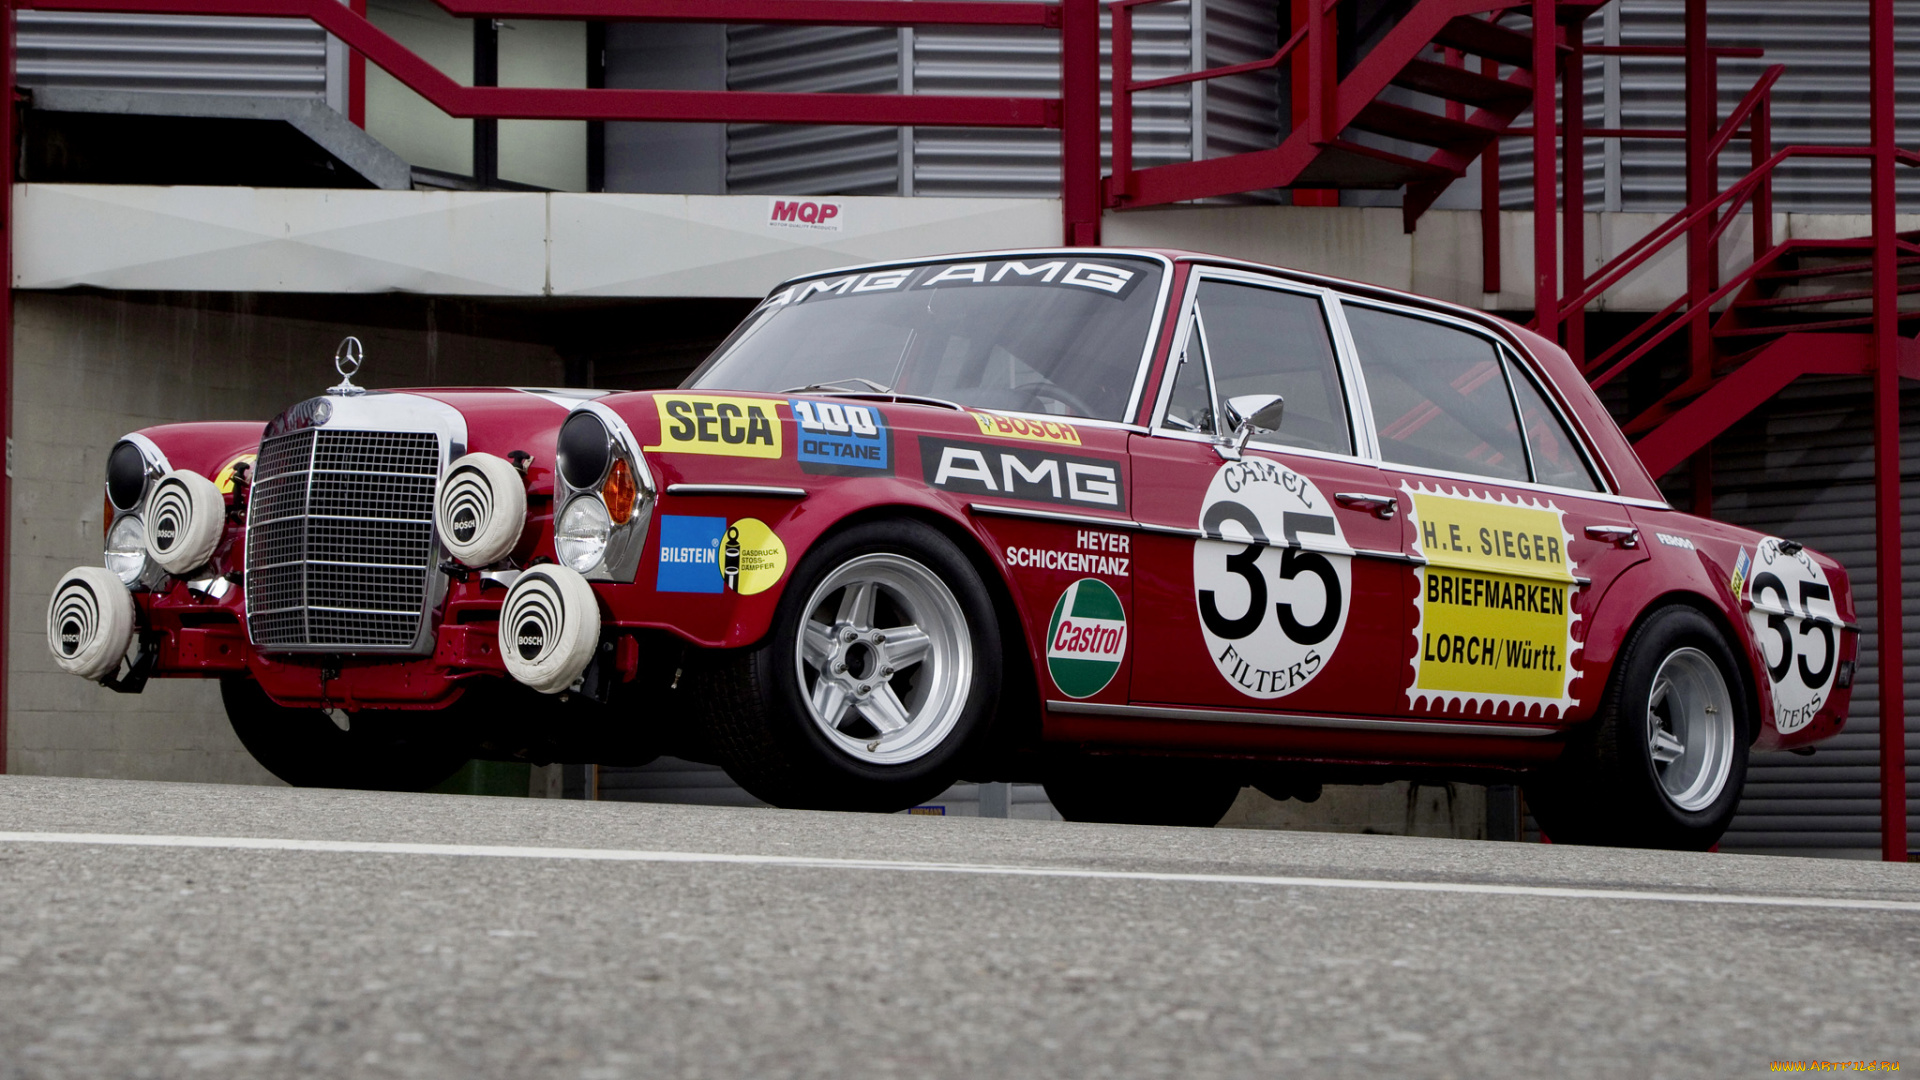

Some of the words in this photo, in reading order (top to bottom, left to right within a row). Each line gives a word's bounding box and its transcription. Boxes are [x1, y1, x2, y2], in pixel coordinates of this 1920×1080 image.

[771, 201, 838, 224] MQP
[756, 268, 915, 310] AMG
[922, 261, 1135, 294] AMG
[666, 400, 774, 446] SECA
[795, 400, 879, 436] 100
[990, 415, 1078, 442] BOSCH
[803, 440, 881, 461] OCTANE
[934, 446, 1119, 506] AMG
[1224, 461, 1313, 509] CAMEL
[157, 529, 176, 539] BOSCH
[454, 519, 476, 531] BOSCH
[1077, 530, 1130, 553] HEYER
[1422, 520, 1472, 553] H.E.
[1479, 527, 1561, 564] SIEGER
[660, 546, 716, 564] BILSTEIN
[741, 548, 779, 557] GASDRUCK
[741, 556, 765, 564] STOSS-
[1006, 546, 1130, 577] SCHICKENTANZ
[1761, 539, 1817, 579] CAEL
[1198, 500, 1343, 646] 35
[1427, 574, 1564, 616] BRIEFMARKEN
[61, 633, 80, 643] BOSCH
[517, 634, 544, 646] BOSCH
[1054, 620, 1125, 655] Castrol
[1751, 571, 1835, 690] 35
[1219, 643, 1322, 693] FILTERS
[1424, 633, 1563, 672] LORCH/Württ.
